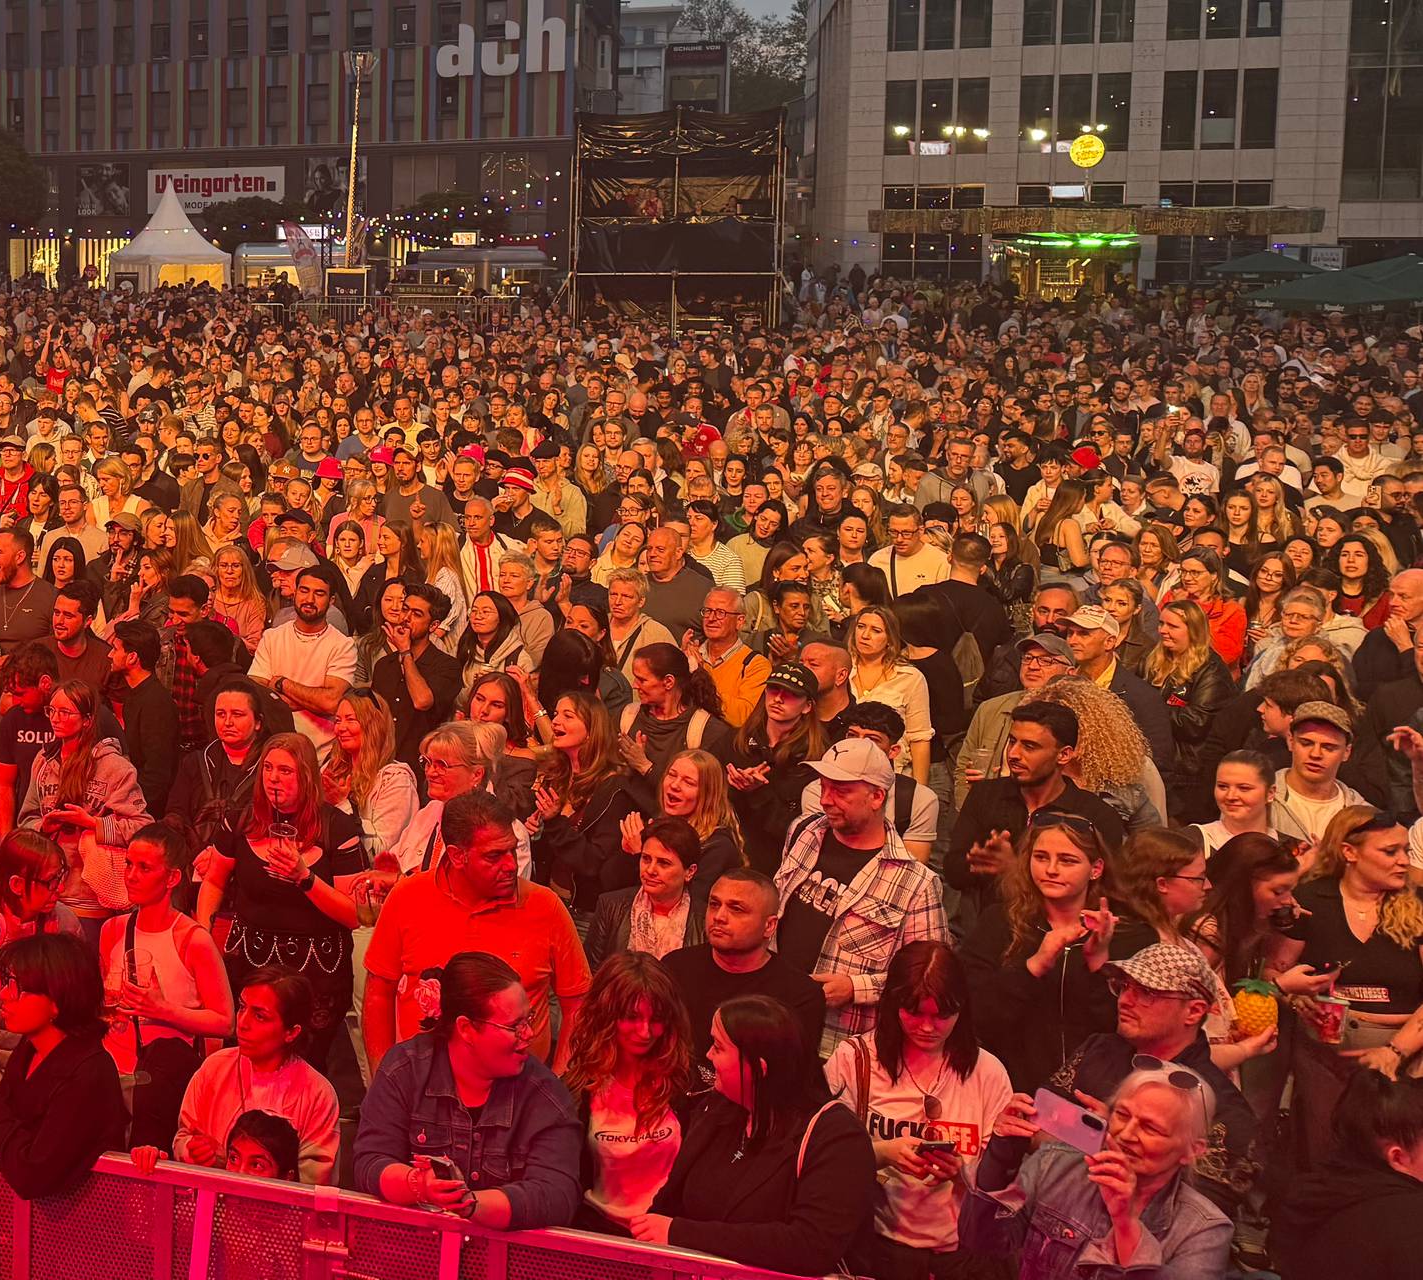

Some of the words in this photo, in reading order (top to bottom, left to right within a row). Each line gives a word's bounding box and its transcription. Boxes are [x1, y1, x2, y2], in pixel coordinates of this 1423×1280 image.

[155, 173, 265, 198] Weingarten
[600, 1134, 638, 1143] TOKYO
[869, 1112, 926, 1140] FUCK
